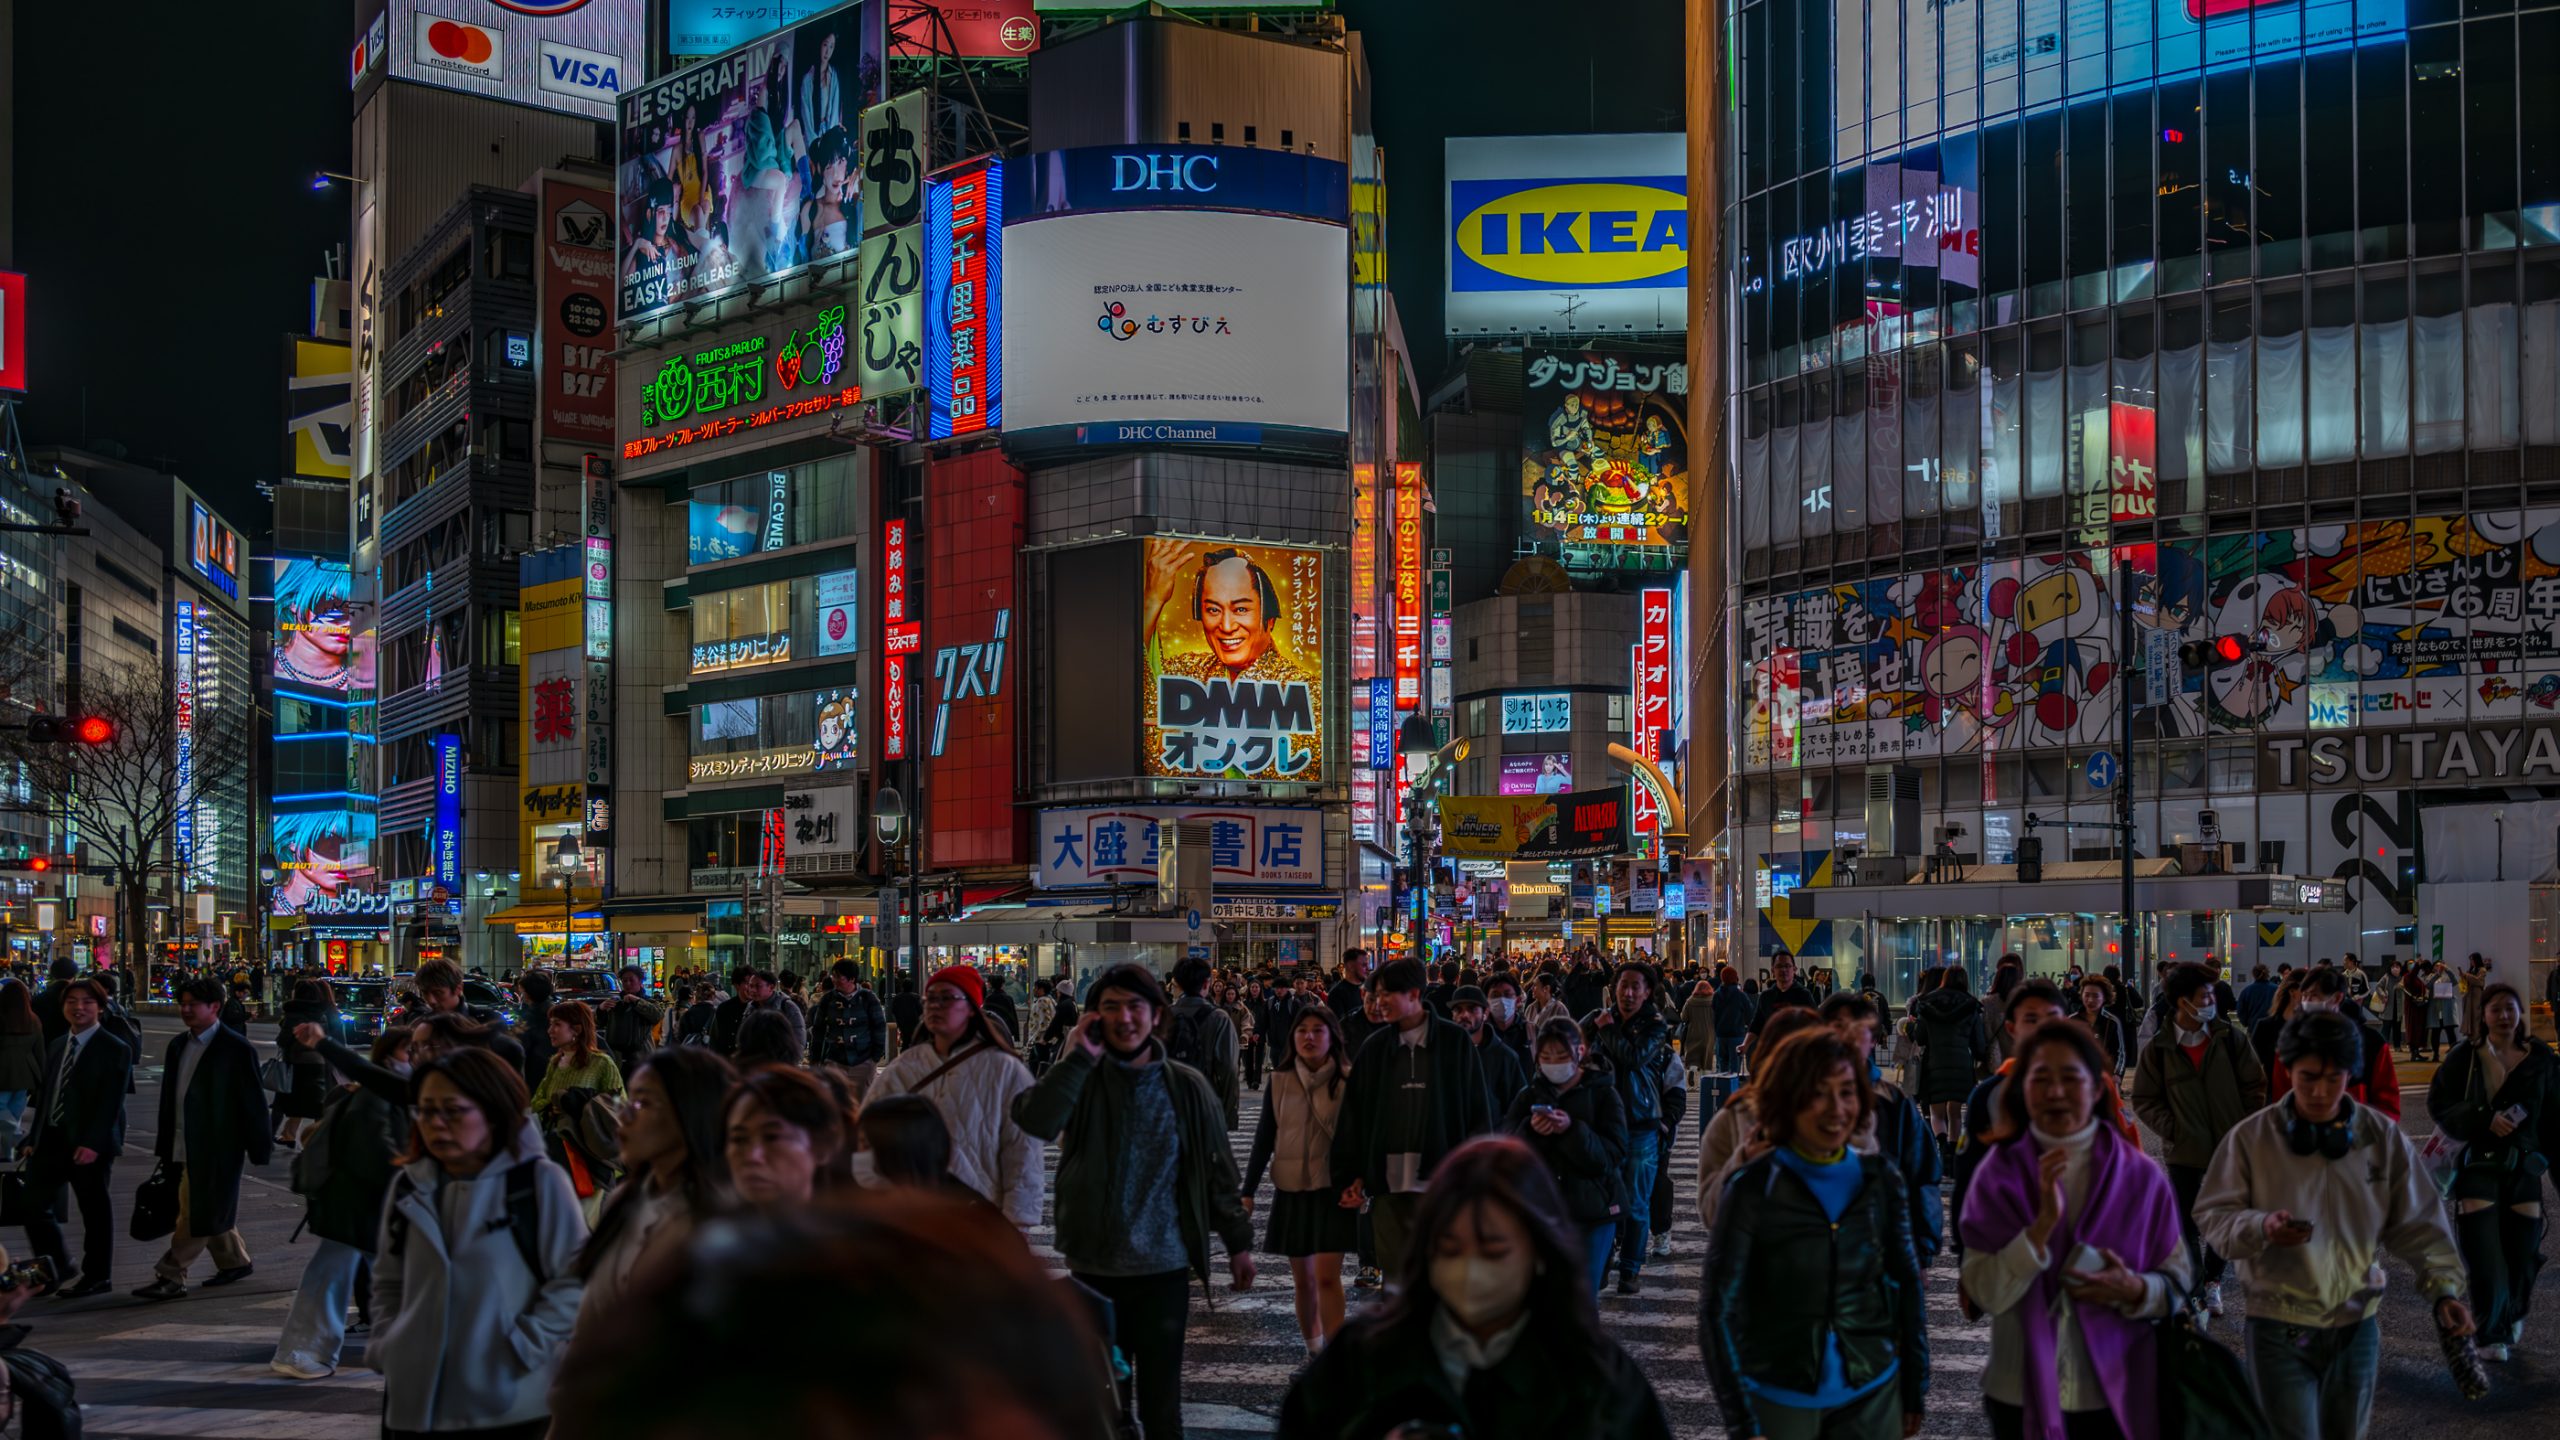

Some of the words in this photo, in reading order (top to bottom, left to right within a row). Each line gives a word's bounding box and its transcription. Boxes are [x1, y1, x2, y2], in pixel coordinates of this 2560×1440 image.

[712, 7, 767, 19] スティック
[957, 11, 979, 19] ピーチ
[679, 35, 729, 45] 第3類医薬品
[1003, 26, 1035, 41] 生薬
[431, 57, 490, 76] mastercard
[543, 53, 619, 92] VISA
[626, 93, 653, 129] LE
[1112, 154, 1218, 192] DHC
[864, 107, 923, 386] もんじゃ
[1481, 210, 1688, 255] IKEA
[623, 274, 641, 286] 3RD
[643, 263, 664, 281] MINI
[665, 254, 698, 273] ALBUM
[624, 277, 667, 311] EASY
[667, 281, 688, 297] 2.19
[690, 261, 740, 290] RELEASE
[951, 184, 976, 418] 三千里薬品
[1146, 315, 1231, 335] むすびえ
[562, 343, 605, 369] B1F
[695, 336, 765, 366] FRUITS&PARLOR
[561, 371, 607, 398] B2F
[695, 356, 764, 413] 西村
[642, 384, 654, 427] 渋谷
[1118, 426, 1153, 440] DHC
[1155, 426, 1217, 440] Channel
[357, 493, 371, 525] 7F
[1400, 469, 1416, 605] クスリのことなら
[888, 525, 903, 619] お好み焼
[2367, 550, 2512, 604] にじさんじ
[524, 597, 568, 613] Matsumoto
[1292, 555, 1304, 661] オンラインの時代へ。
[1306, 556, 1318, 646] クレーンゲームは
[178, 616, 191, 653] LABI
[281, 623, 319, 633] BEAUTY
[1745, 598, 1875, 666] 常識を
[1396, 615, 1420, 700] 三千里
[1645, 604, 1669, 713] カラオケ
[2480, 650, 2518, 660] RENEWAL
[931, 608, 1010, 757] クスリ
[178, 692, 191, 729] LABI
[534, 673, 577, 744] 薬
[887, 660, 902, 755] もんじゃ焼
[1160, 677, 1313, 732] DMM
[1520, 698, 1569, 713] れいわ
[1374, 682, 1389, 766] 大盛堂商事ビル
[1505, 716, 1569, 732] クリニック
[444, 745, 457, 795] MIZUHO
[815, 750, 857, 770] Jasmine
[1163, 731, 1309, 774] オンクレ
[2267, 727, 2560, 786] TSUTAYA
[280, 861, 318, 871] BEAUTY
[1261, 871, 1282, 879] BOOKS
[1284, 871, 1313, 880] TAISEIDO
[304, 885, 389, 914] グルメタウン
[1230, 897, 1276, 905] TAISEIDO
